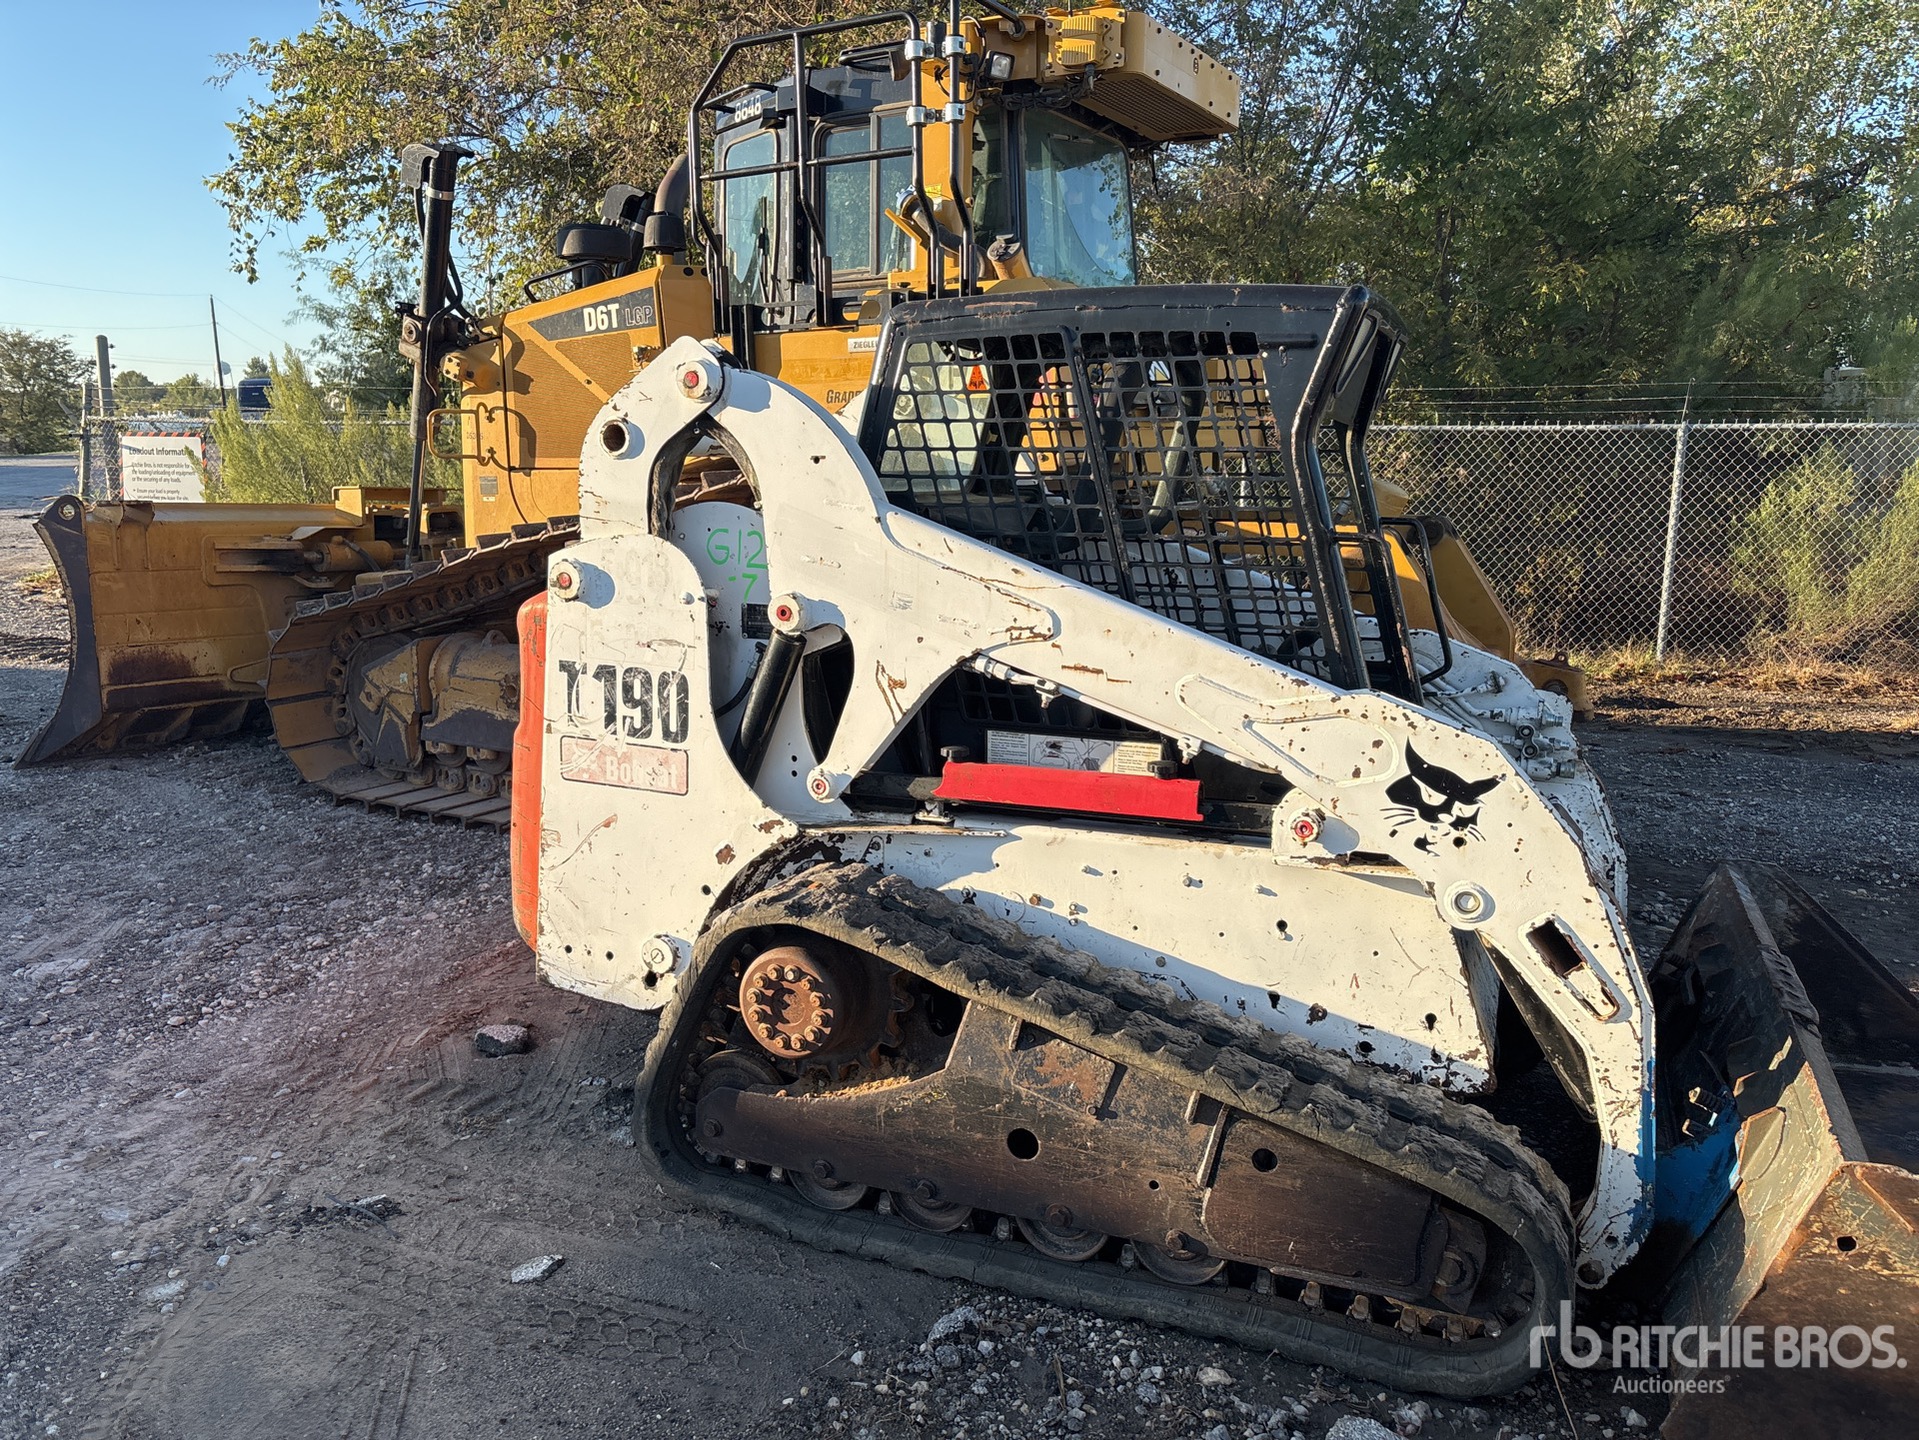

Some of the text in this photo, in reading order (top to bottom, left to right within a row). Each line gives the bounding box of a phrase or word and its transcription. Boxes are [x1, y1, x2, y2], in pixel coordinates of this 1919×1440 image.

[583, 303, 653, 332] D6T LGP
[129, 446, 155, 456] Loadout
[706, 528, 768, 570] G12
[559, 660, 690, 743] T190
